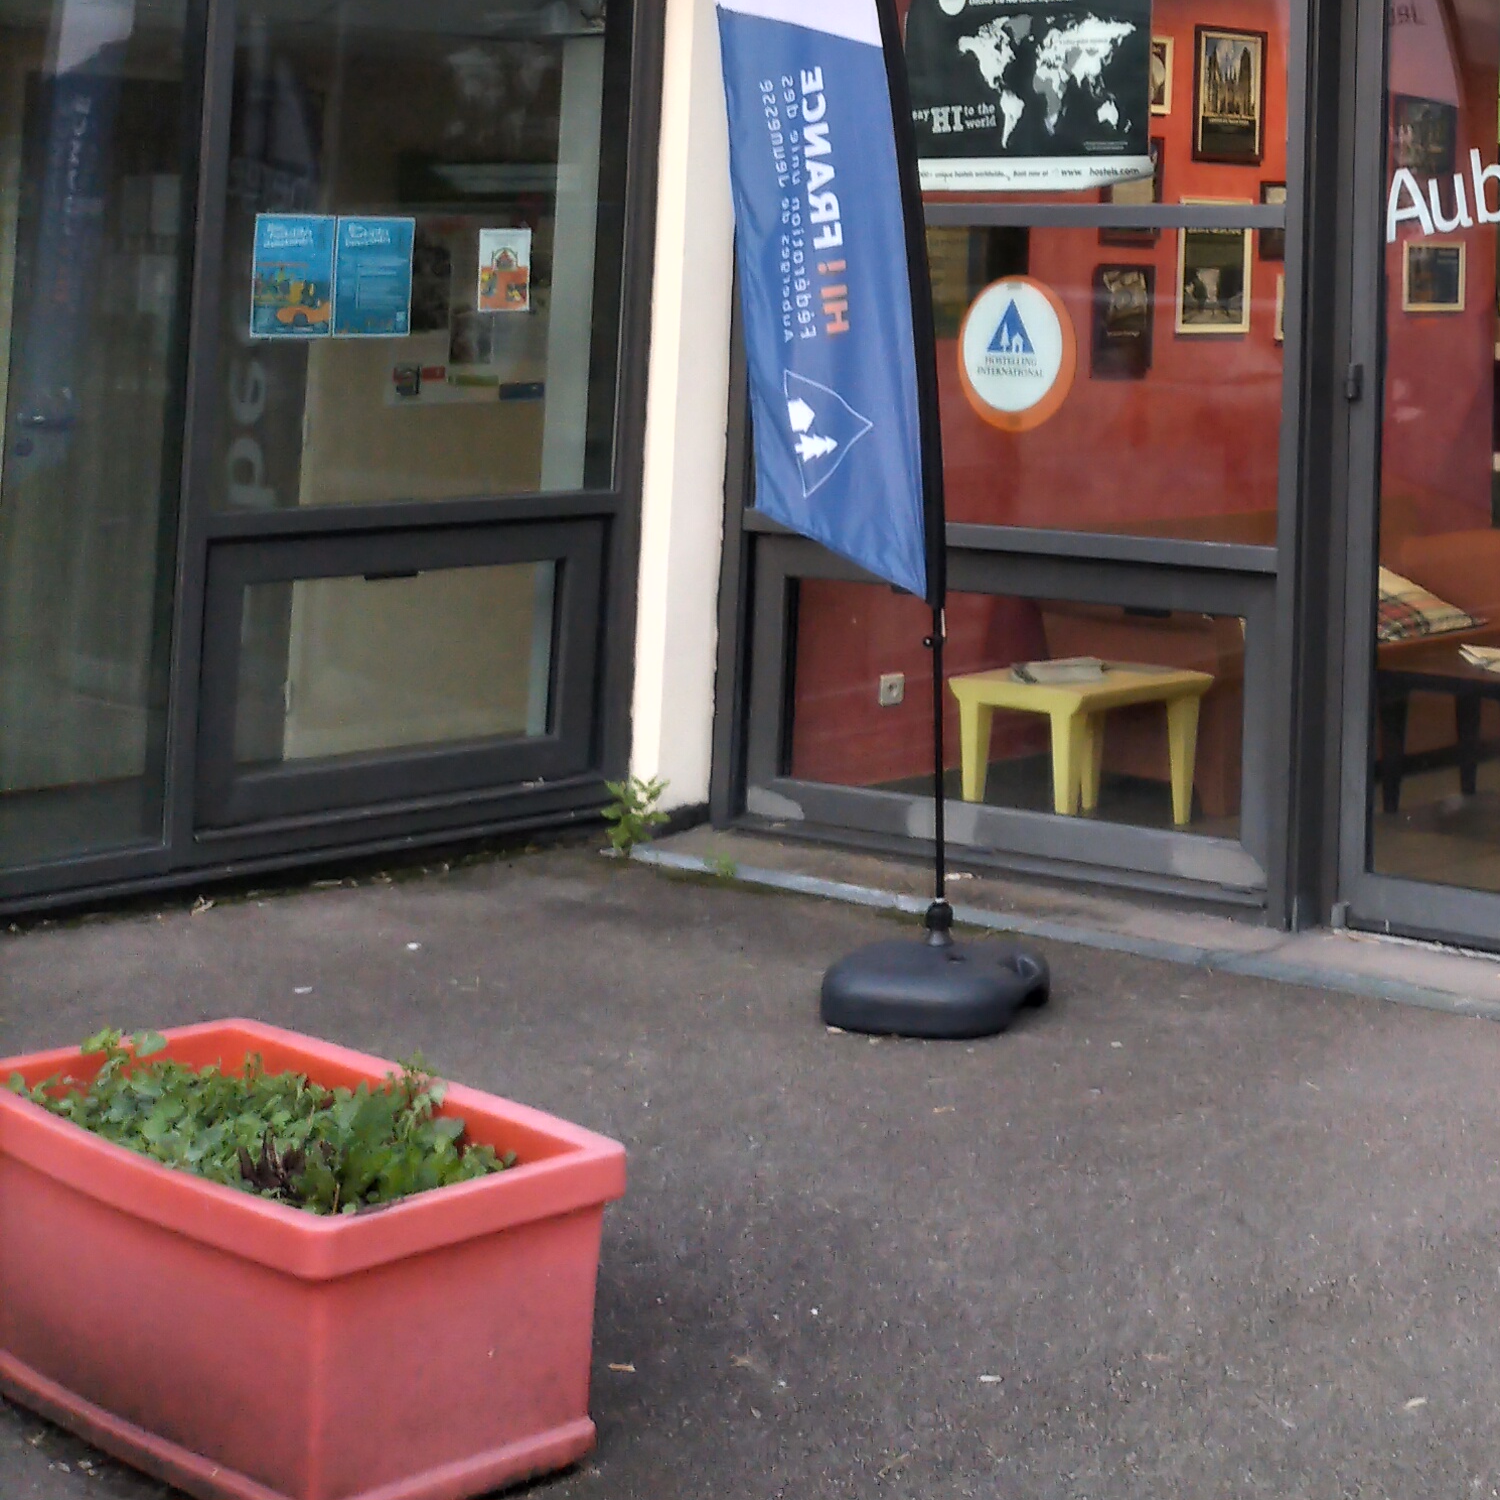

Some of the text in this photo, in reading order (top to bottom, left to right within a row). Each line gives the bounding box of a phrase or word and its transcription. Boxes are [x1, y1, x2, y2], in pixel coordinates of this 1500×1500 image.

[931, 105, 963, 134] HI
[964, 105, 976, 117] to
[978, 102, 996, 115] the
[965, 115, 997, 130] world
[977, 366, 1043, 378] INTERNATIONAL
